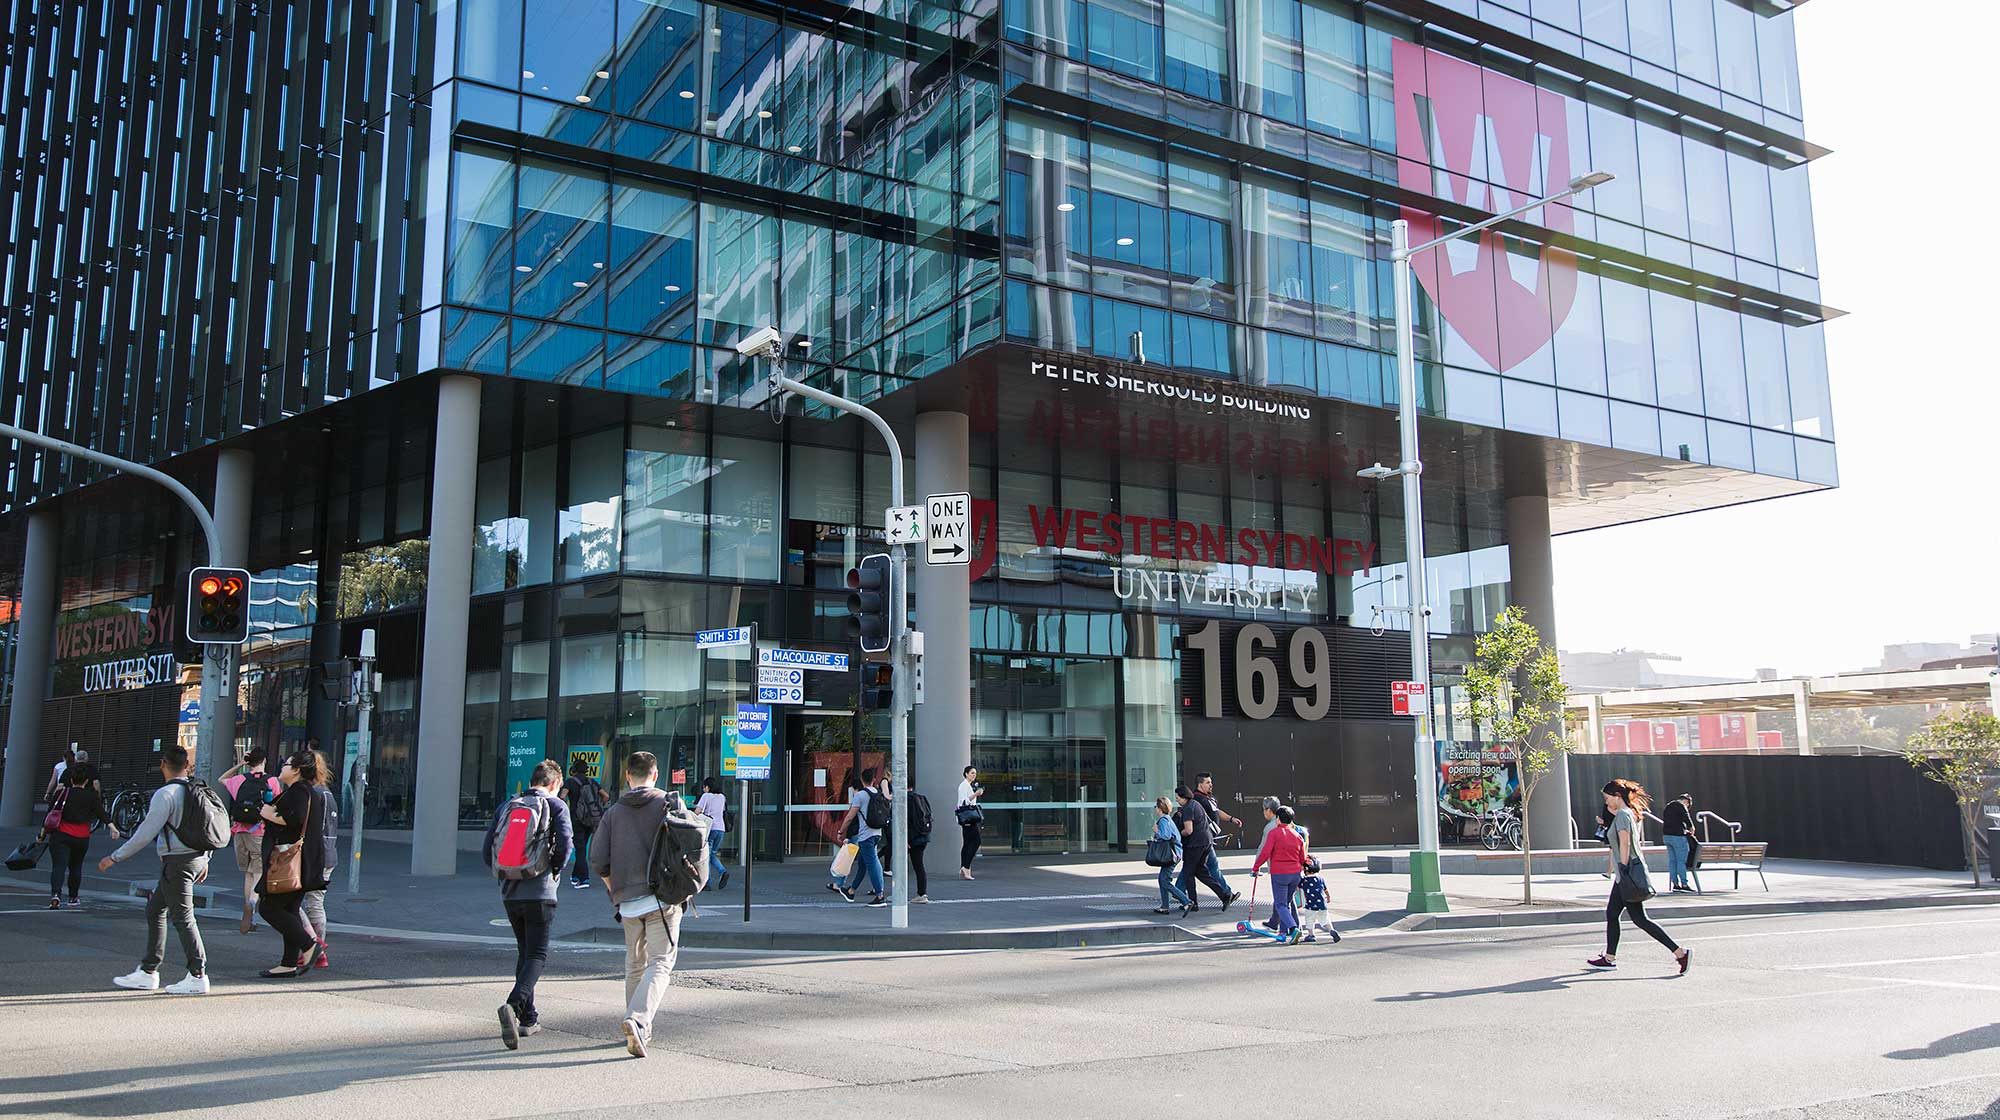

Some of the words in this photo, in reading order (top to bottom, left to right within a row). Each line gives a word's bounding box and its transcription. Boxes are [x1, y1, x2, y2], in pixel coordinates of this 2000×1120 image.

[1031, 361, 1100, 385] PETER
[932, 500, 964, 517] ONE
[931, 522, 965, 539] WAY
[1028, 504, 1225, 562] WESTERN
[1238, 527, 1377, 578] SYDNEY
[1109, 566, 1317, 613] UNIVERSITY
[56, 611, 140, 659] WESTERN
[698, 631, 725, 643] SMITH
[727, 630, 739, 640] ST
[773, 650, 831, 665] MACQUARIE
[833, 655, 847, 666] ST
[760, 669, 788, 677] UNITING
[1184, 619, 1332, 721] 169
[759, 675, 788, 683] CHURCH
[780, 688, 788, 700] P
[738, 711, 750, 720] CITY
[750, 711, 768, 721] CENTRE
[738, 721, 749, 731] CAR
[749, 721, 762, 731] PARK
[510, 730, 528, 739] OPTUS
[509, 745, 536, 756] Business
[1482, 751, 1498, 760] new
[509, 758, 523, 767] Hub
[570, 751, 599, 763] NOW
[1448, 765, 1480, 777] opening
